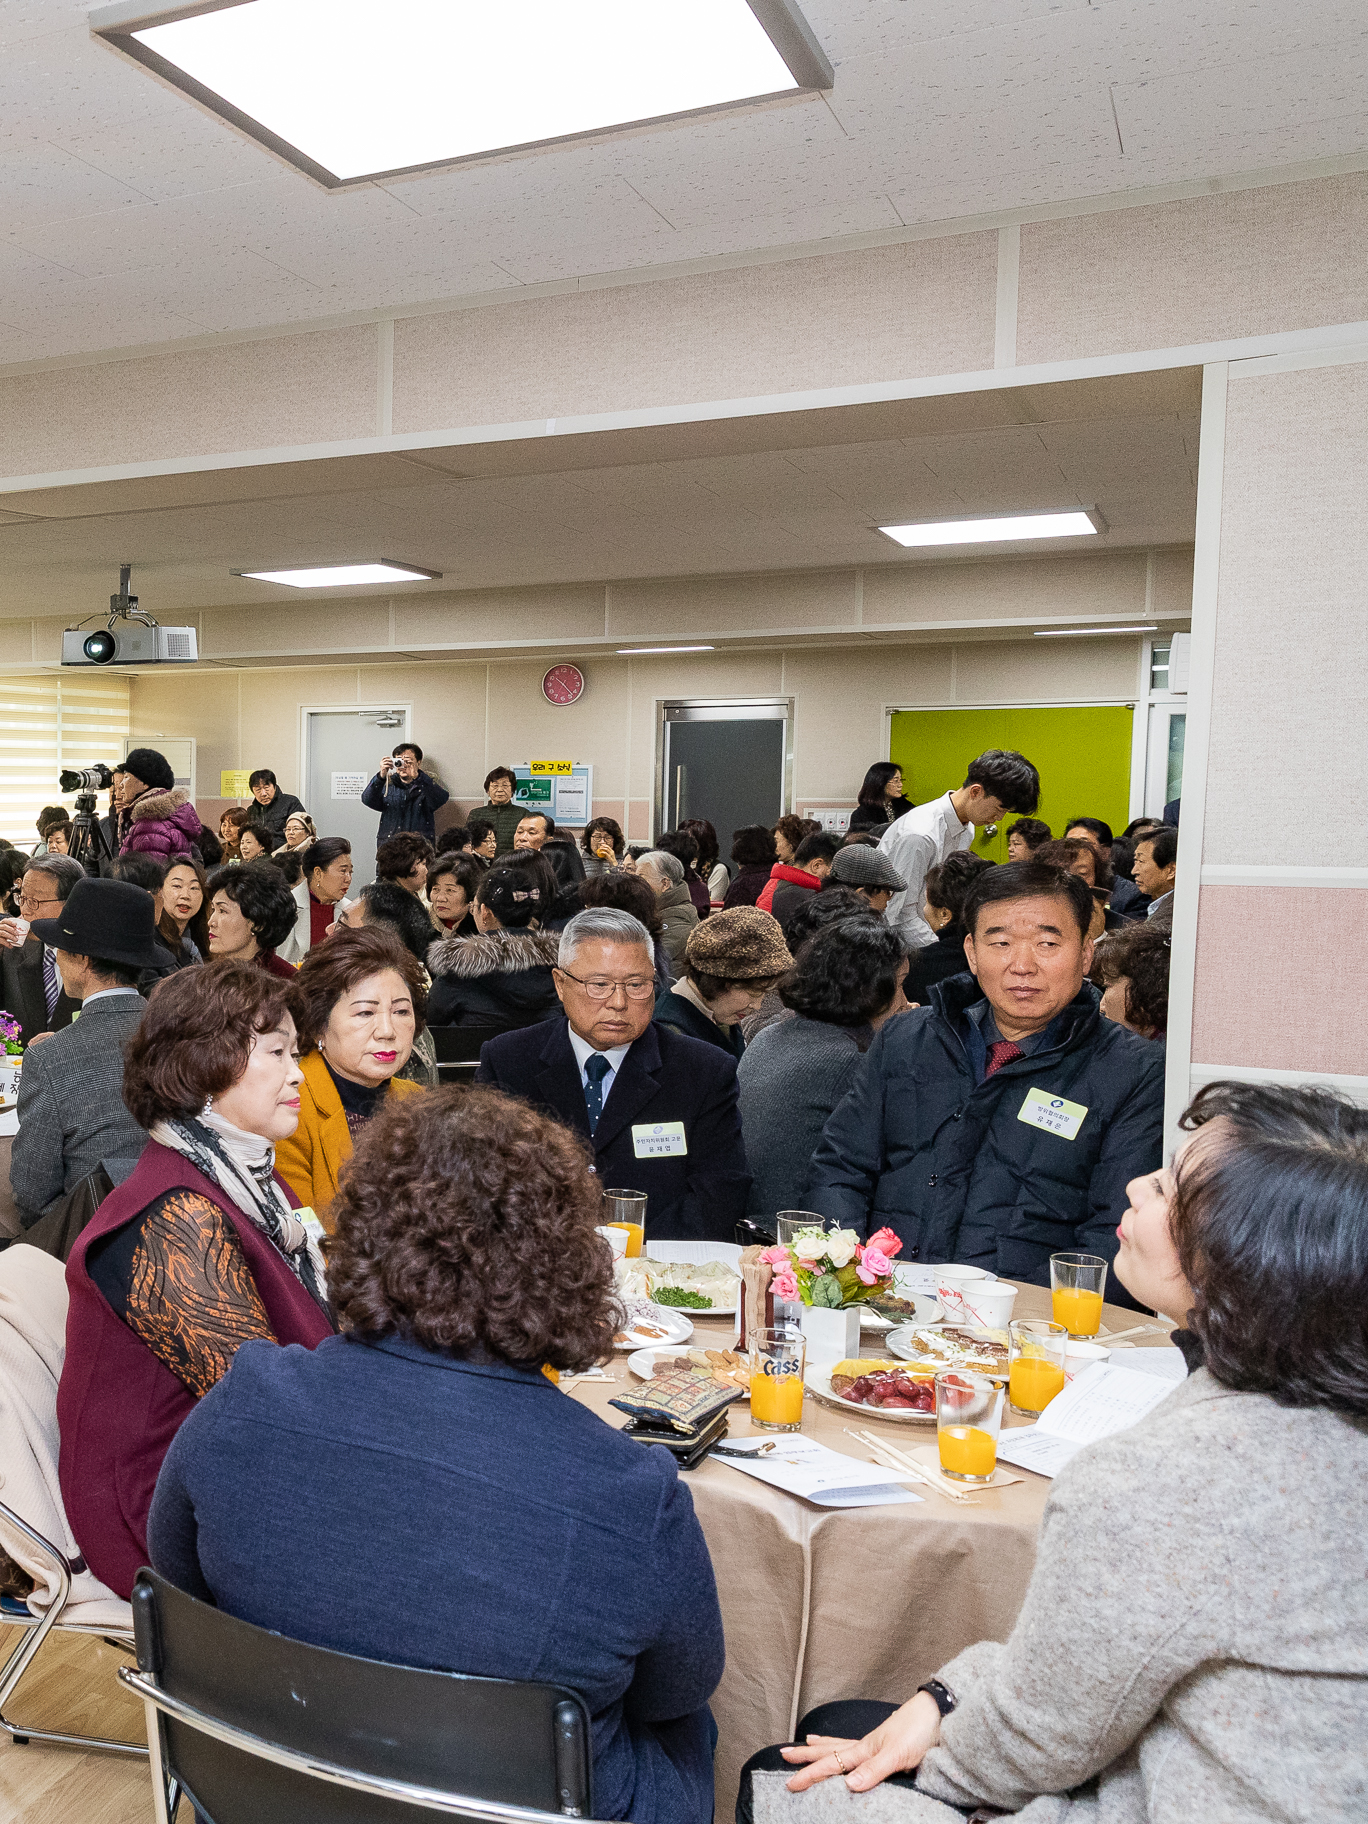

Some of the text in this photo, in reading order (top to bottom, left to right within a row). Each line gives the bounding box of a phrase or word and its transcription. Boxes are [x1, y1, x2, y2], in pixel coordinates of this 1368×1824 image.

[532, 763, 571, 771] 우리 구 소식
[636, 1136, 670, 1145] 주민자치위원회
[763, 1358, 800, 1377] Cass
